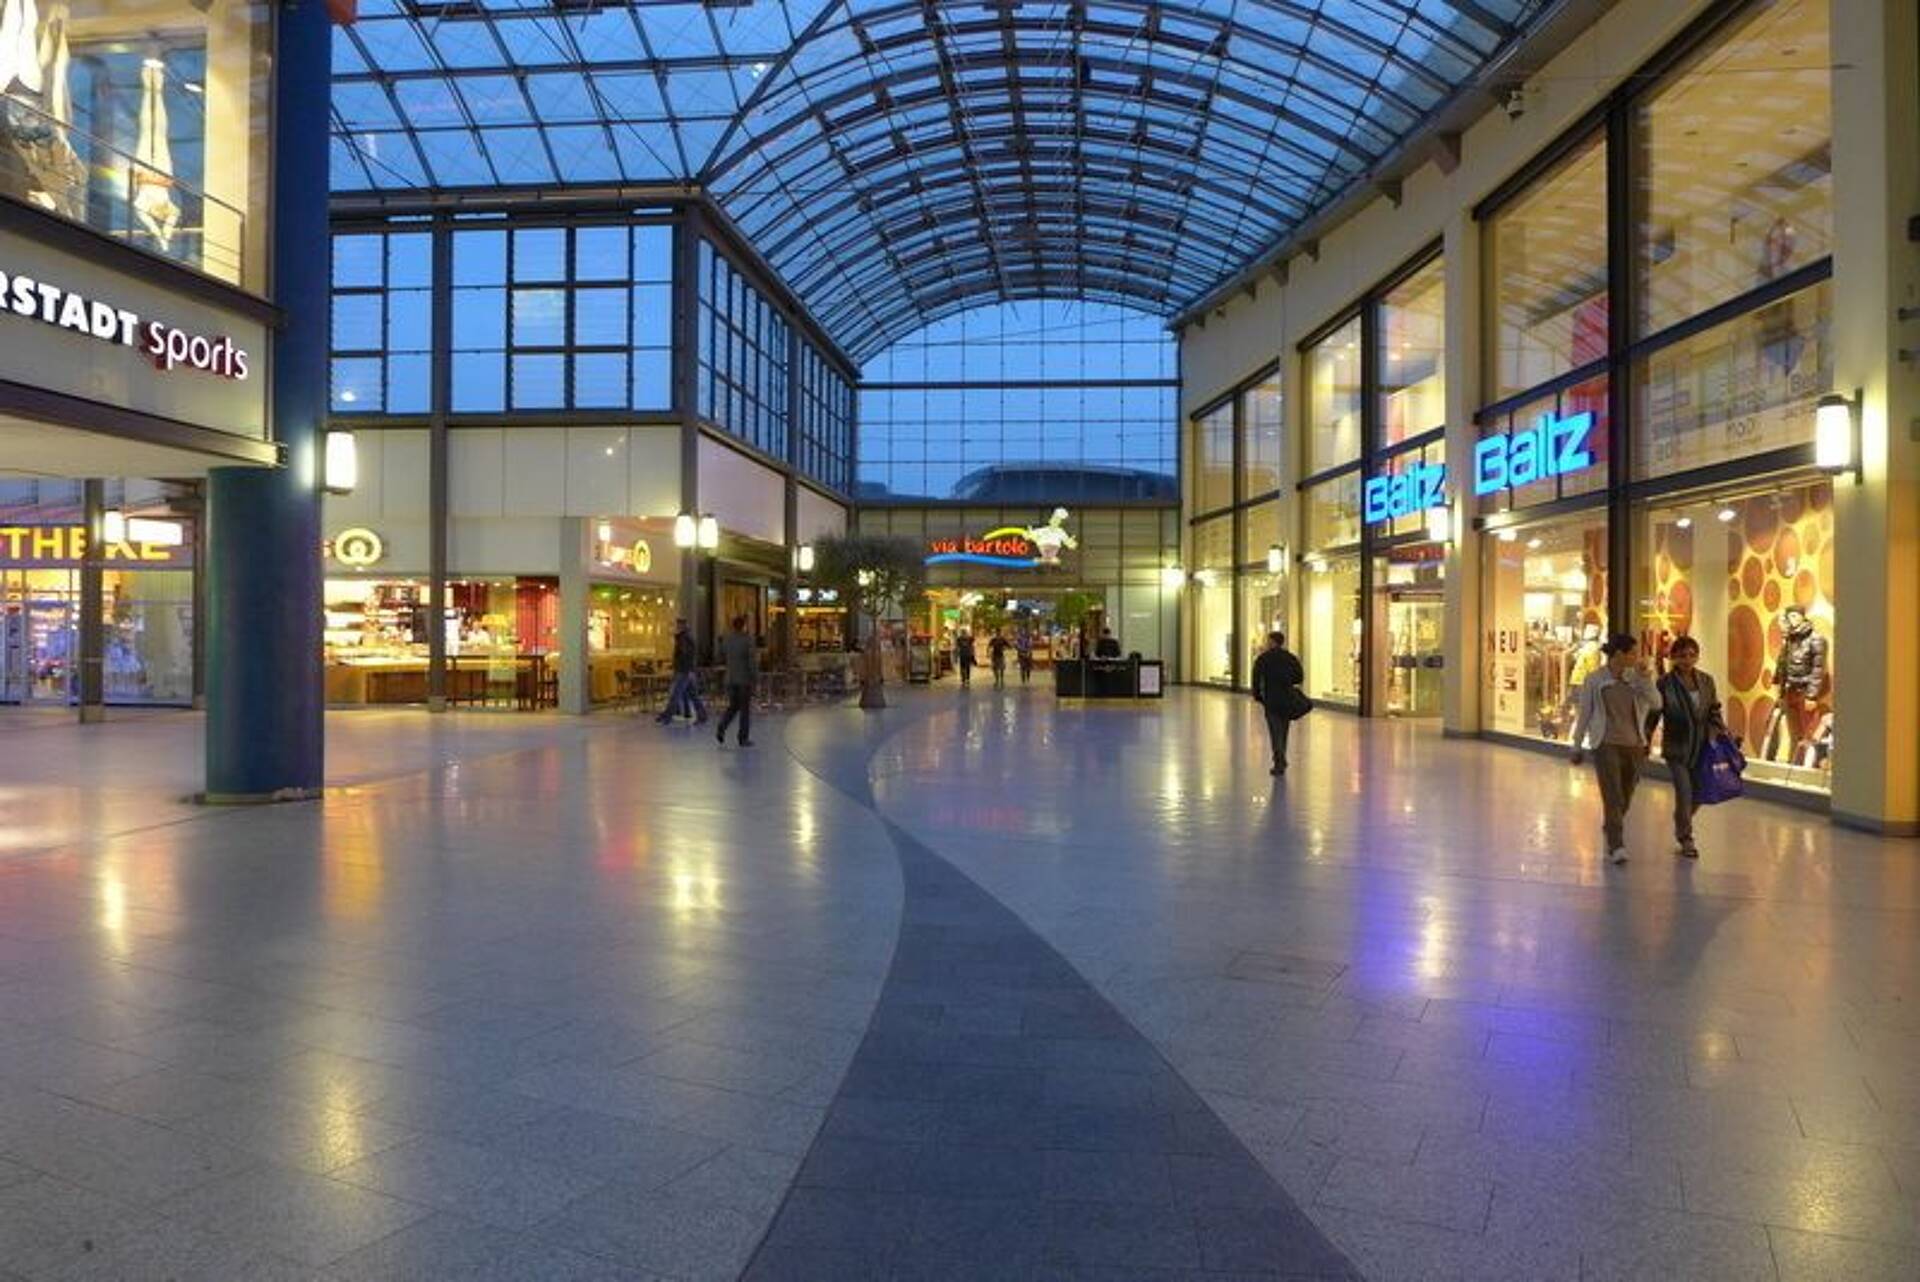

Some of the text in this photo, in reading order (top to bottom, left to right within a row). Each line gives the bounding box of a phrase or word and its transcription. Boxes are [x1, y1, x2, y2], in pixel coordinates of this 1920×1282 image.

[150, 320, 248, 381] sports
[1474, 411, 1594, 496] Baltz
[1365, 462, 1445, 523] Baltz
[931, 535, 1029, 556] via bartolo
[1487, 630, 1518, 654] NEU
